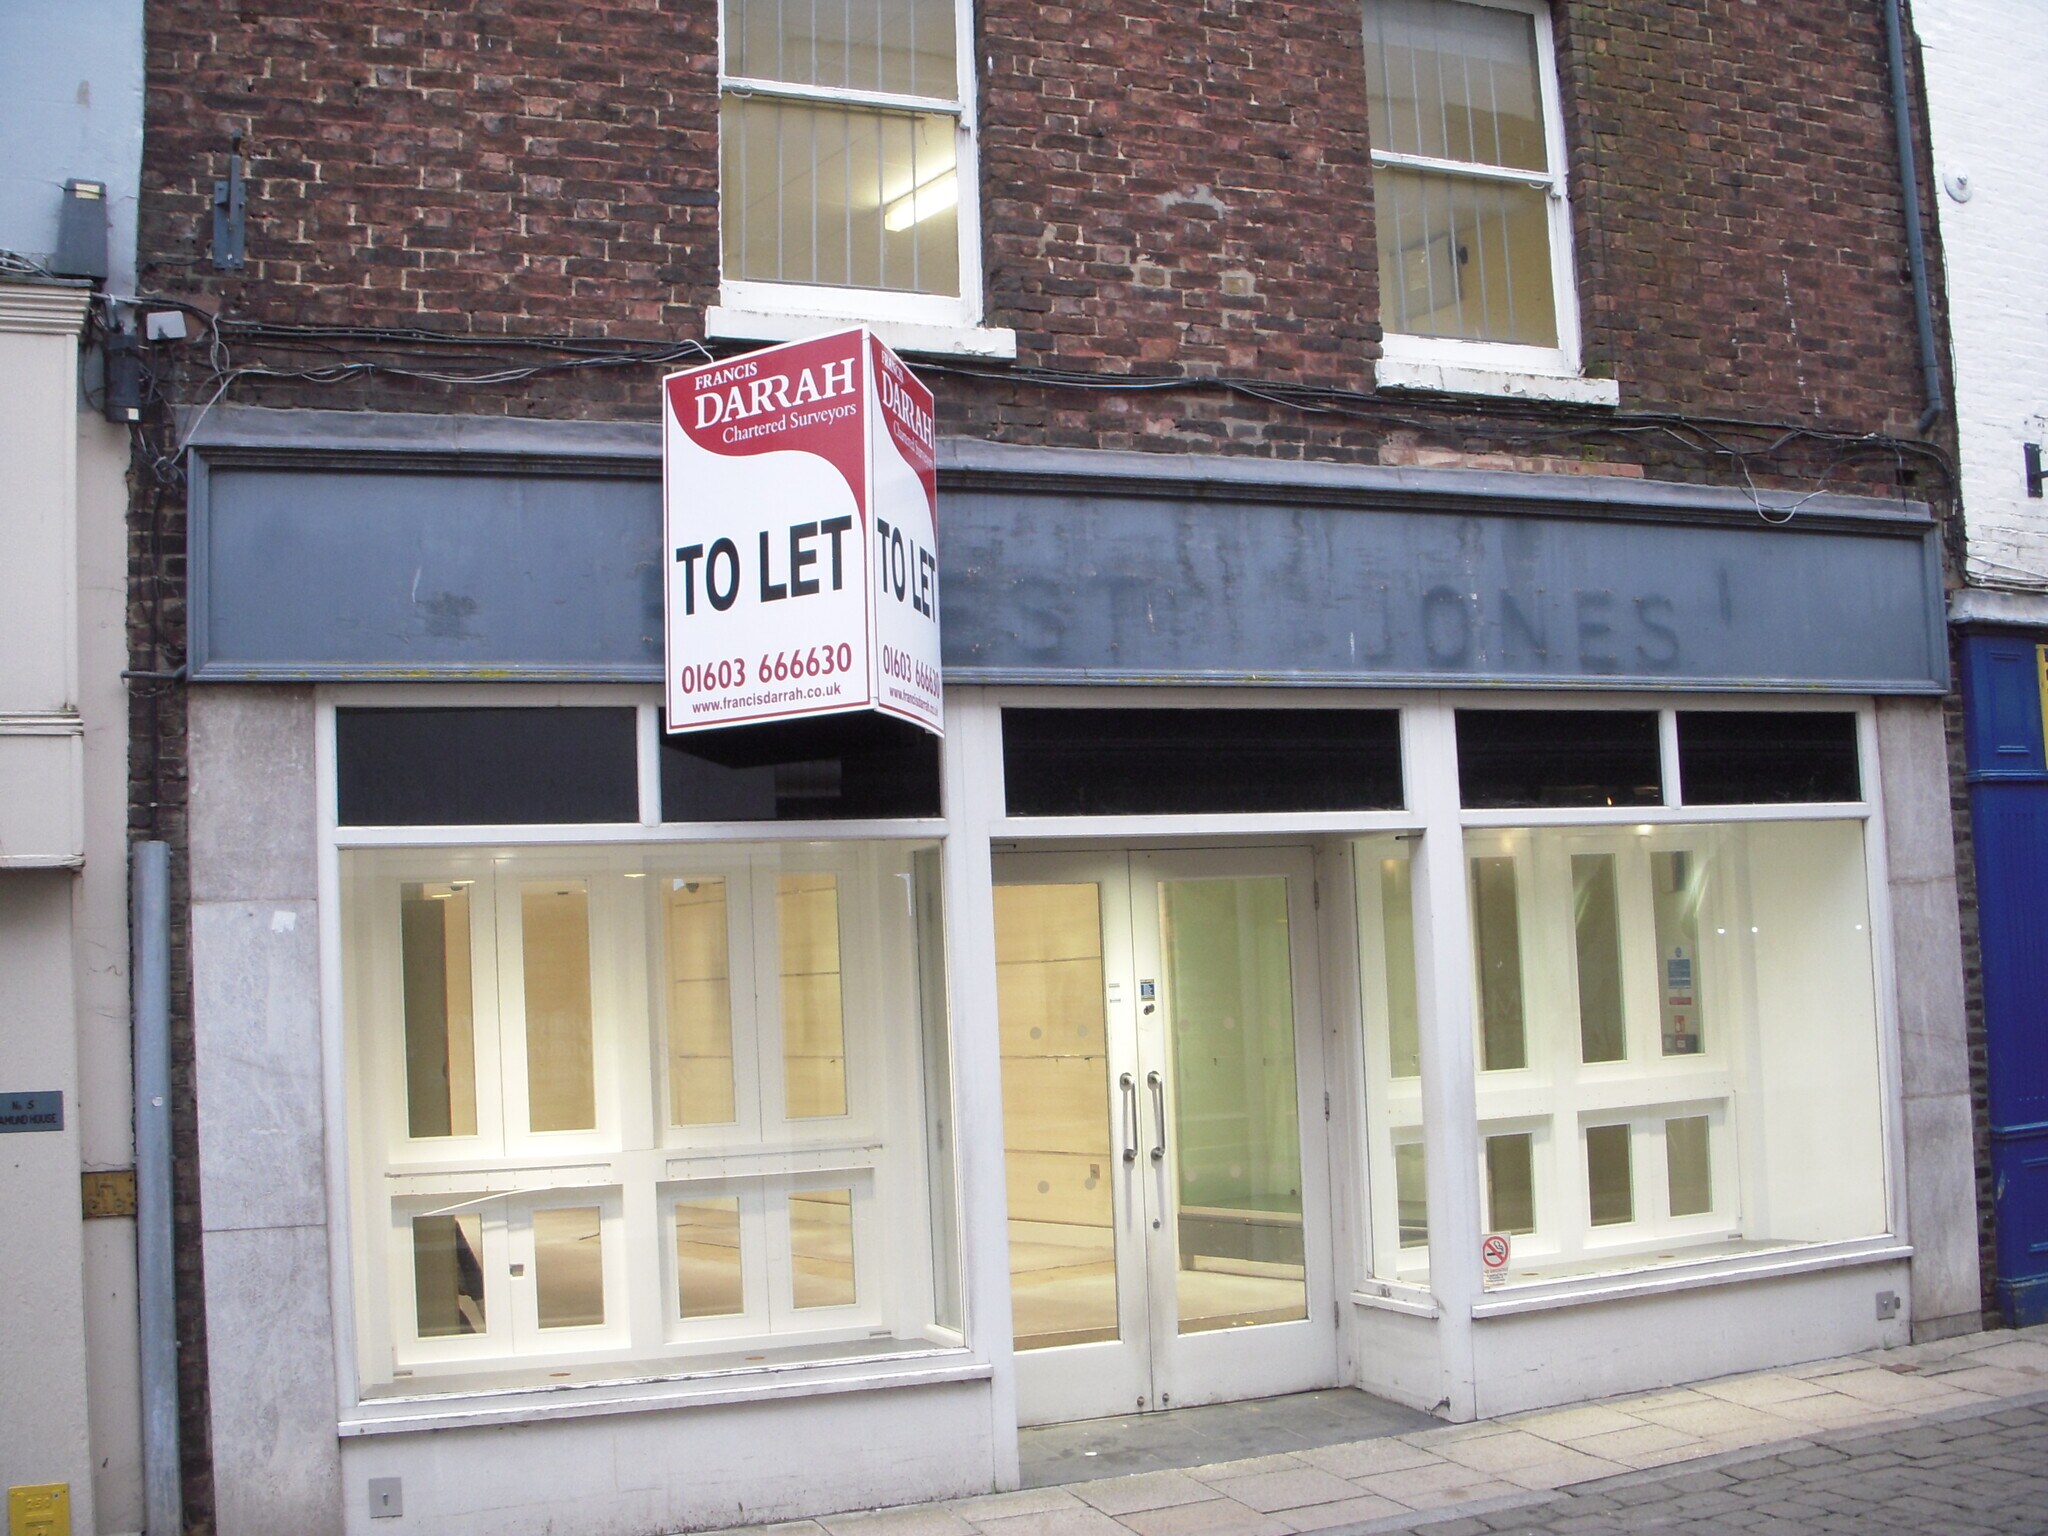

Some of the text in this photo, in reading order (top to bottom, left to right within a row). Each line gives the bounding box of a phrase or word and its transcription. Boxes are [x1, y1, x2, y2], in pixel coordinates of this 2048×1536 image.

[695, 362, 757, 390] FRANCIS
[695, 358, 855, 429] DARRAH
[723, 403, 857, 443] Chartered Surveyors
[881, 369, 933, 450] DARRAH
[676, 515, 852, 615] TO LET
[877, 516, 936, 623] TO LET
[682, 642, 851, 694] 01603 666630
[883, 644, 911, 683] 01603
[692, 682, 841, 713] www.francisdarrah.co.uk
